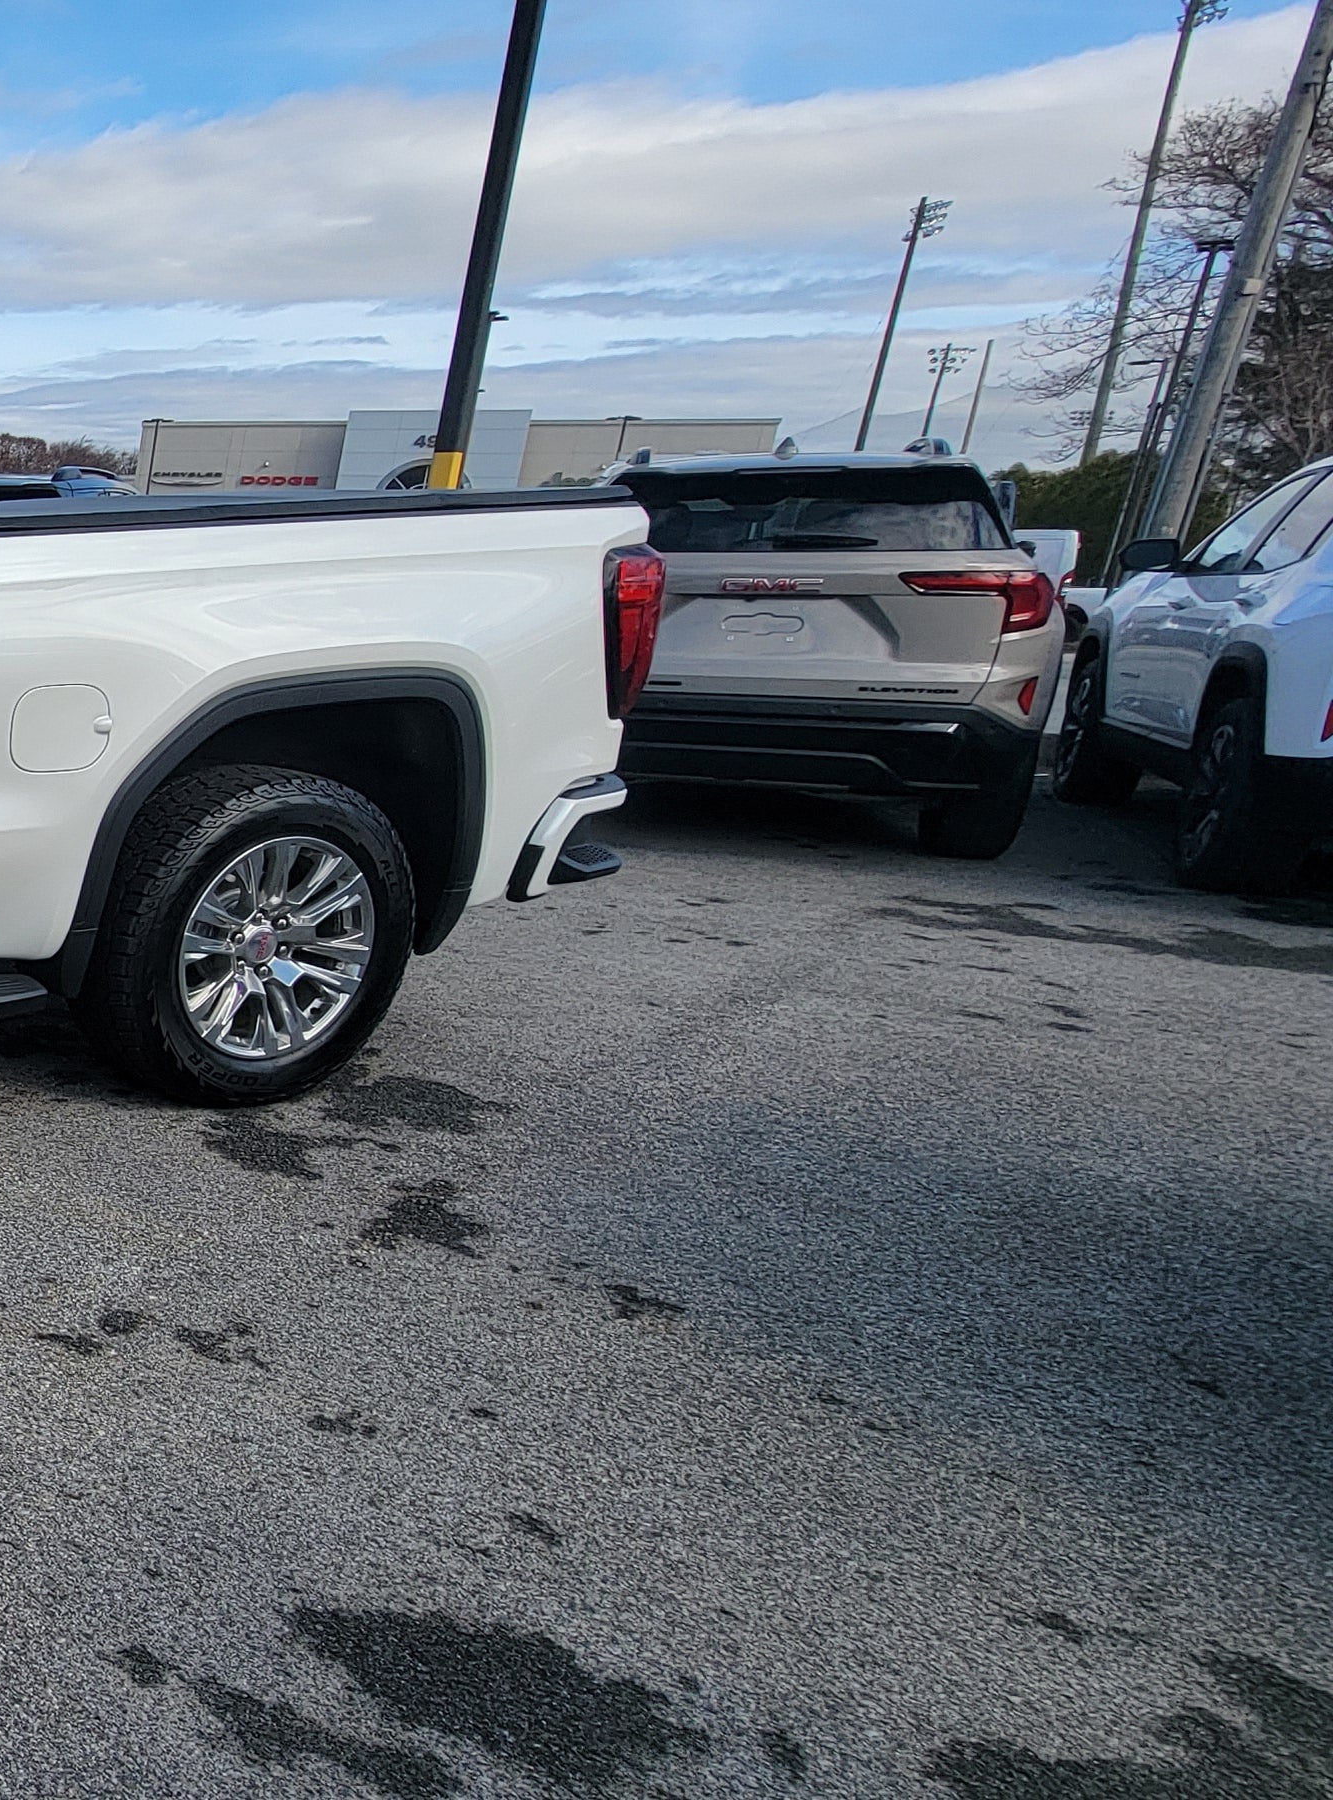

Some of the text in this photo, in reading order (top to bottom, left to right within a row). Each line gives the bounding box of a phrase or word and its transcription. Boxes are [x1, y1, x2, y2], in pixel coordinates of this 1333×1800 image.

[413, 434, 436, 449] 49
[239, 475, 319, 486] DODGE
[720, 577, 824, 592] GMC
[858, 685, 960, 696] ELEVATION
